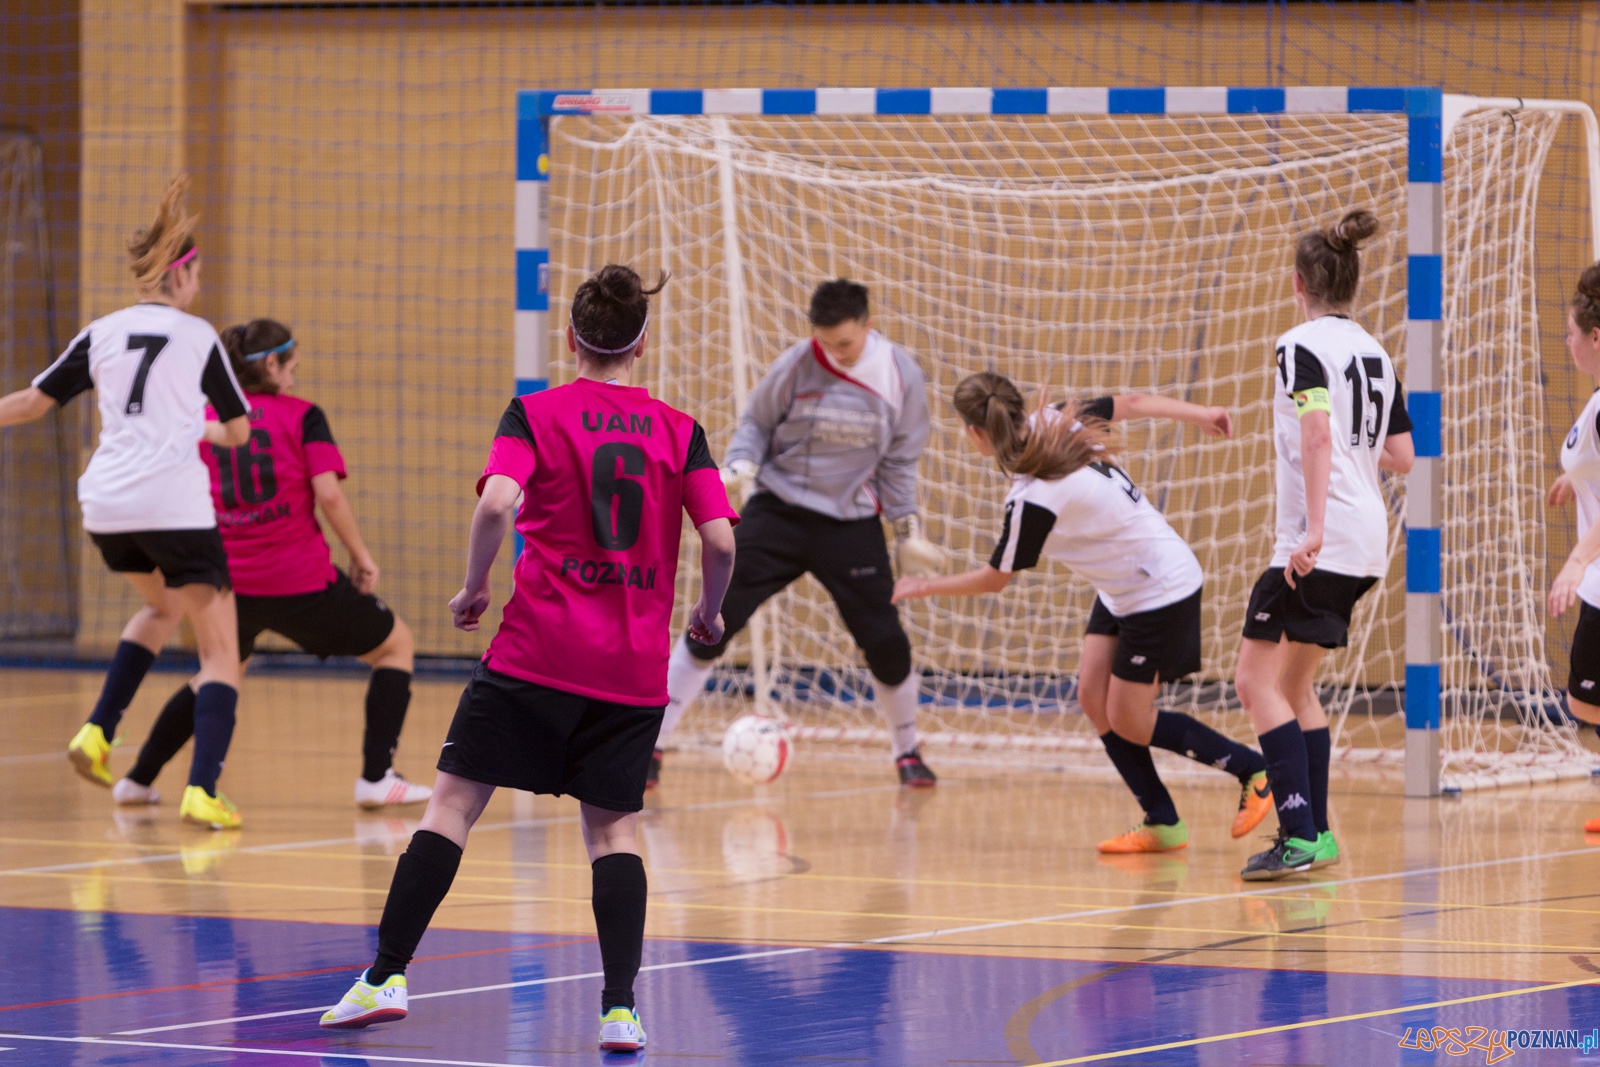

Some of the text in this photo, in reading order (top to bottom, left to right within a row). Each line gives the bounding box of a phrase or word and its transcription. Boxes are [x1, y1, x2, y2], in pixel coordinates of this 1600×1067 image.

[125, 332, 171, 415] 7
[1343, 353, 1385, 449] 15
[581, 411, 653, 437] UAM
[211, 428, 278, 510] 16
[591, 441, 646, 552] 6
